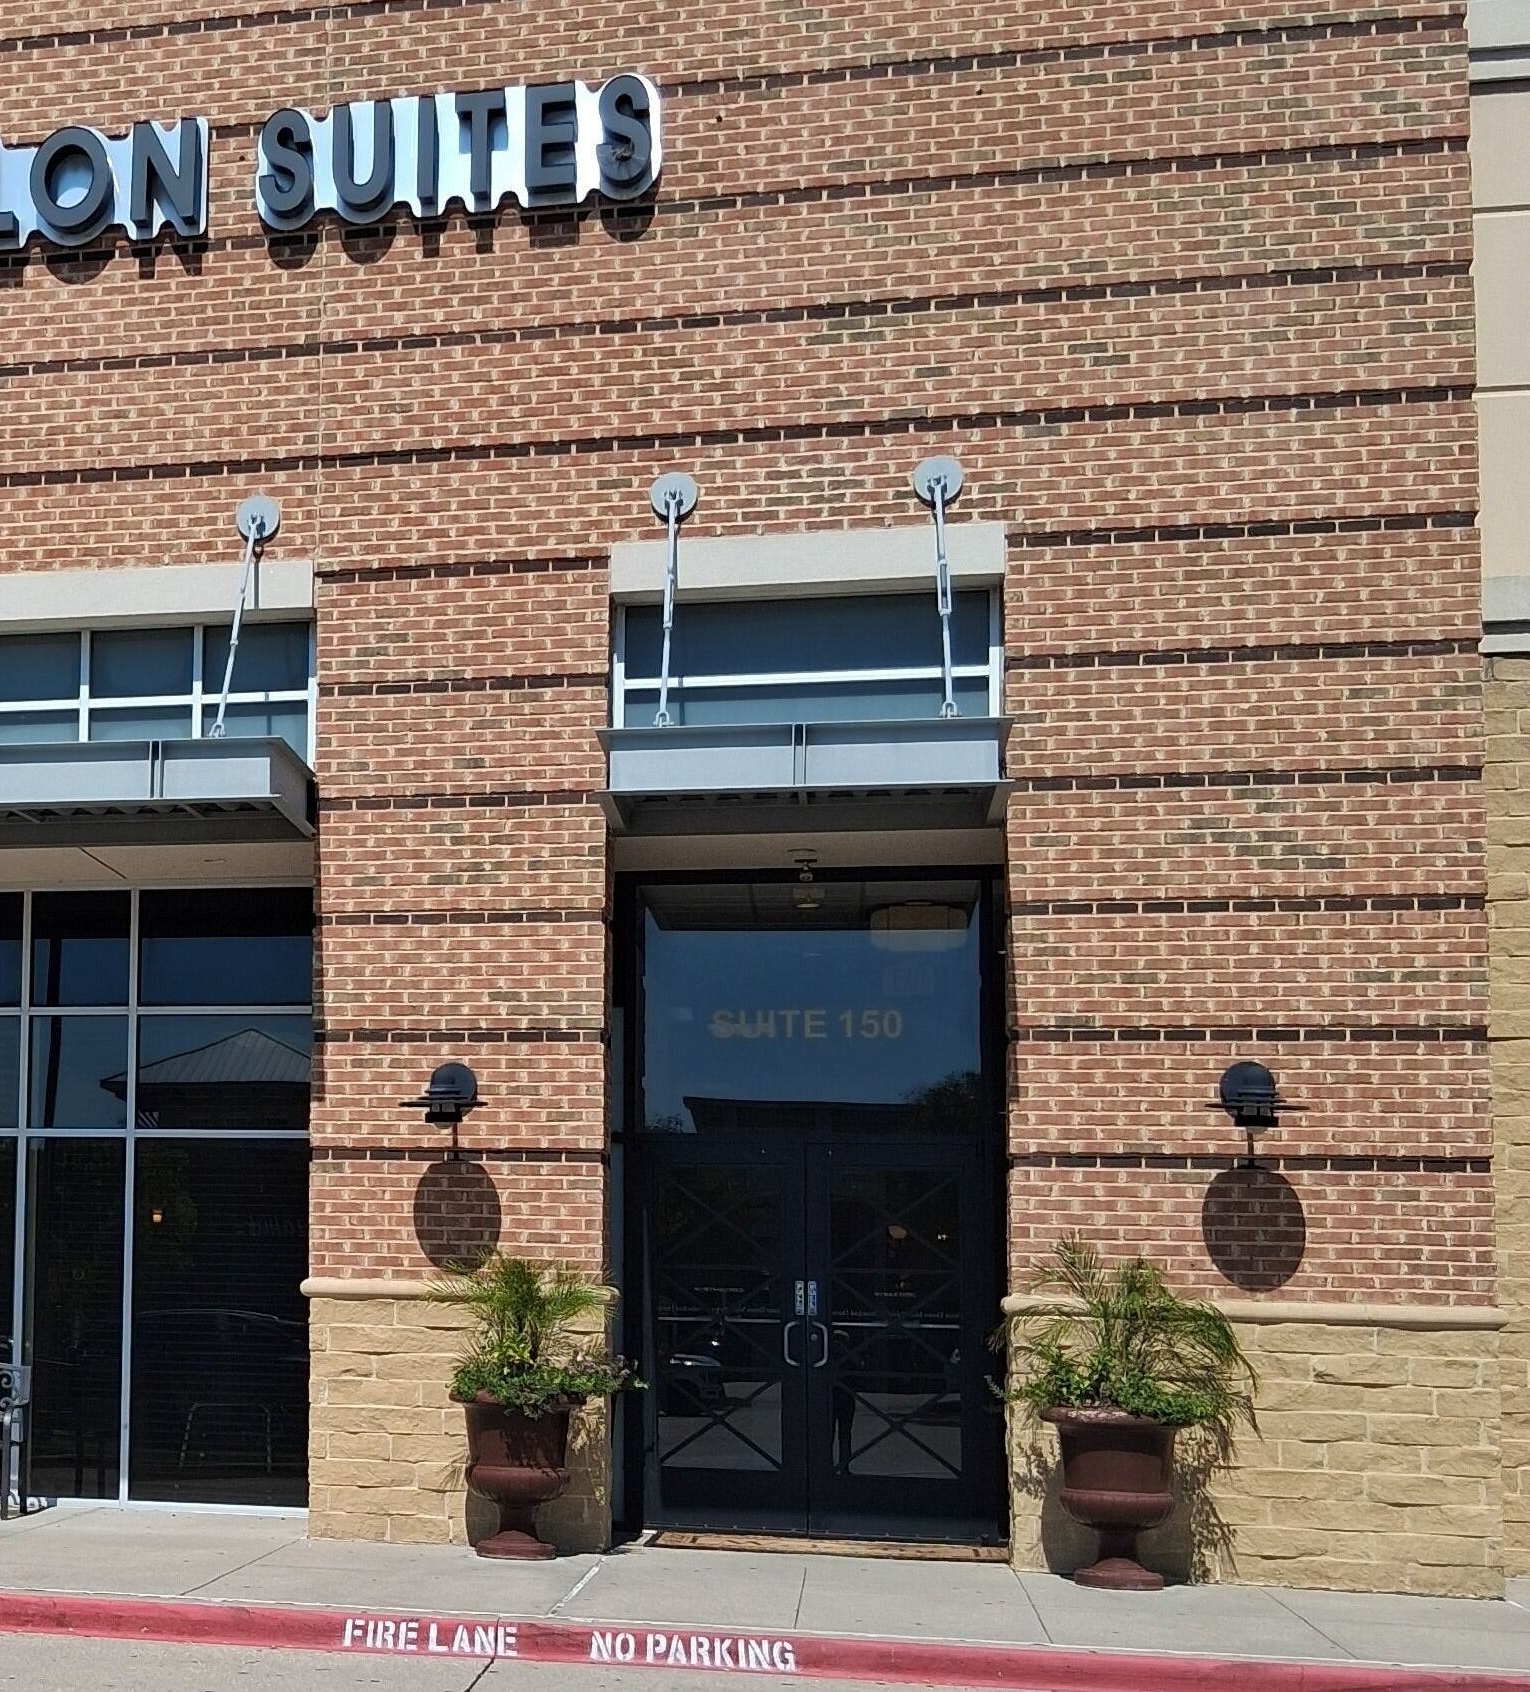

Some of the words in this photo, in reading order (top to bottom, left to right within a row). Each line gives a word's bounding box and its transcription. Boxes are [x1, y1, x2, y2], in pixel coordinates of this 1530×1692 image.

[258, 72, 662, 232] SUITES
[709, 1008, 828, 1040] SUITE
[838, 1008, 904, 1040] 150
[343, 1618, 419, 1651] FIRE
[428, 1622, 518, 1657] LANE
[589, 1630, 636, 1661] NO
[646, 1633, 796, 1672] PARKING
